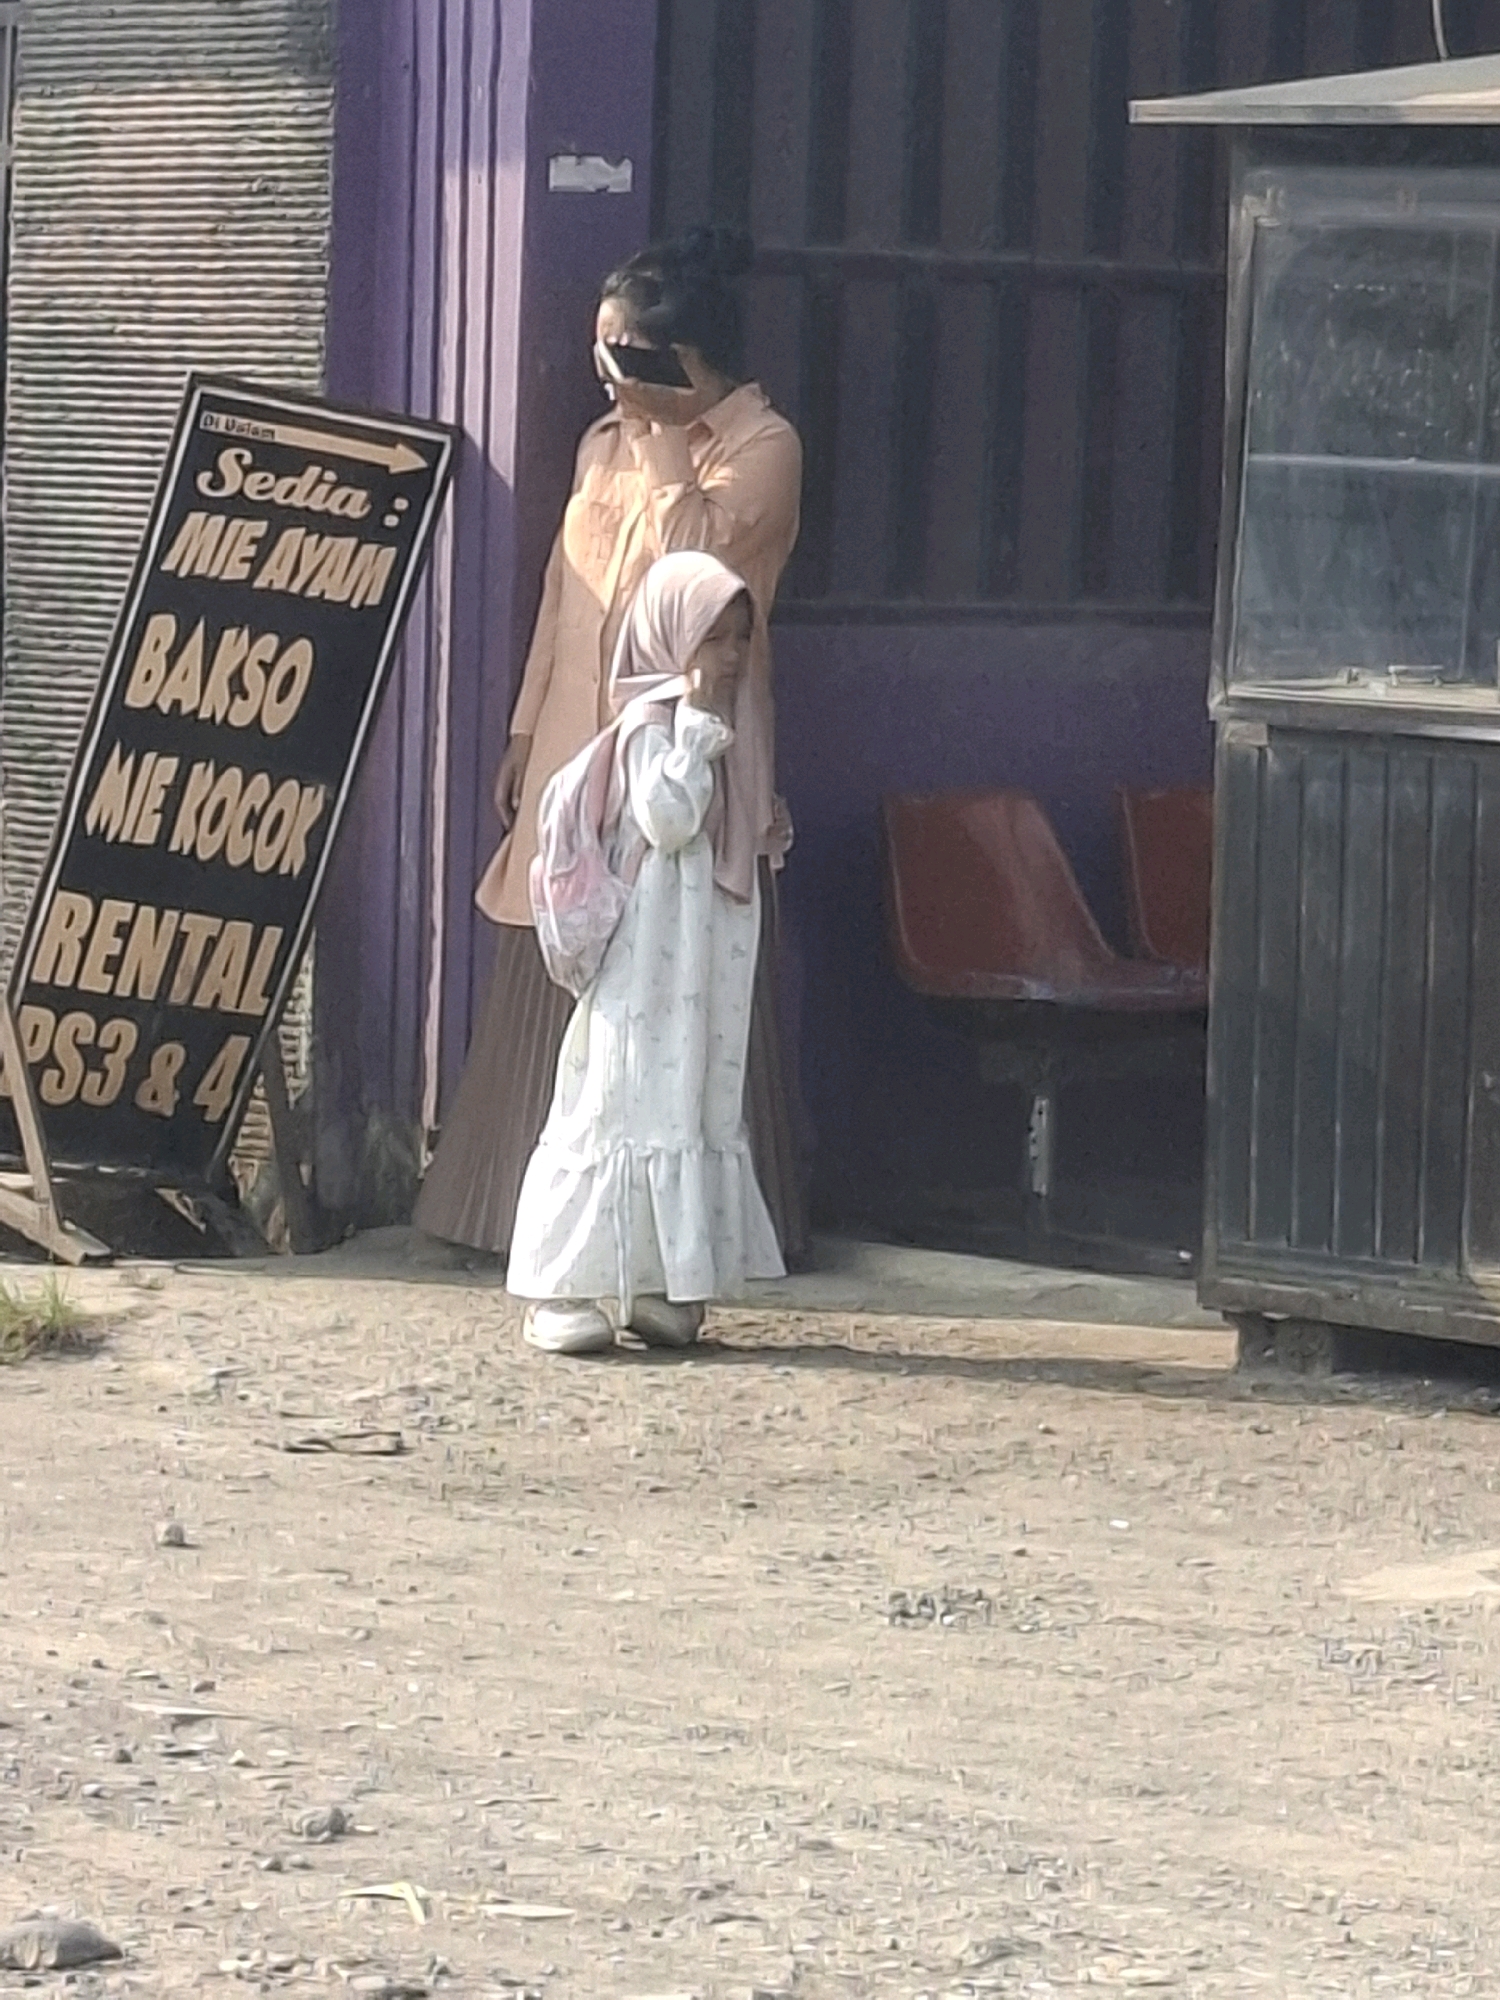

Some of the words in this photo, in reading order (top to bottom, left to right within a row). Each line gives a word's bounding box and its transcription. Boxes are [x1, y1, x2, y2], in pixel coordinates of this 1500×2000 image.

[196, 448, 372, 519] Sedia
[160, 511, 268, 580] MIE
[252, 527, 397, 609] AYAM
[124, 613, 313, 734] BAKSO
[85, 738, 180, 845] MIE
[167, 758, 326, 880] KOCOK
[30, 889, 284, 1017] RENTAL
[0, 1004, 138, 1107] PS3
[135, 1042, 187, 1117] &
[192, 1034, 251, 1122] 4
